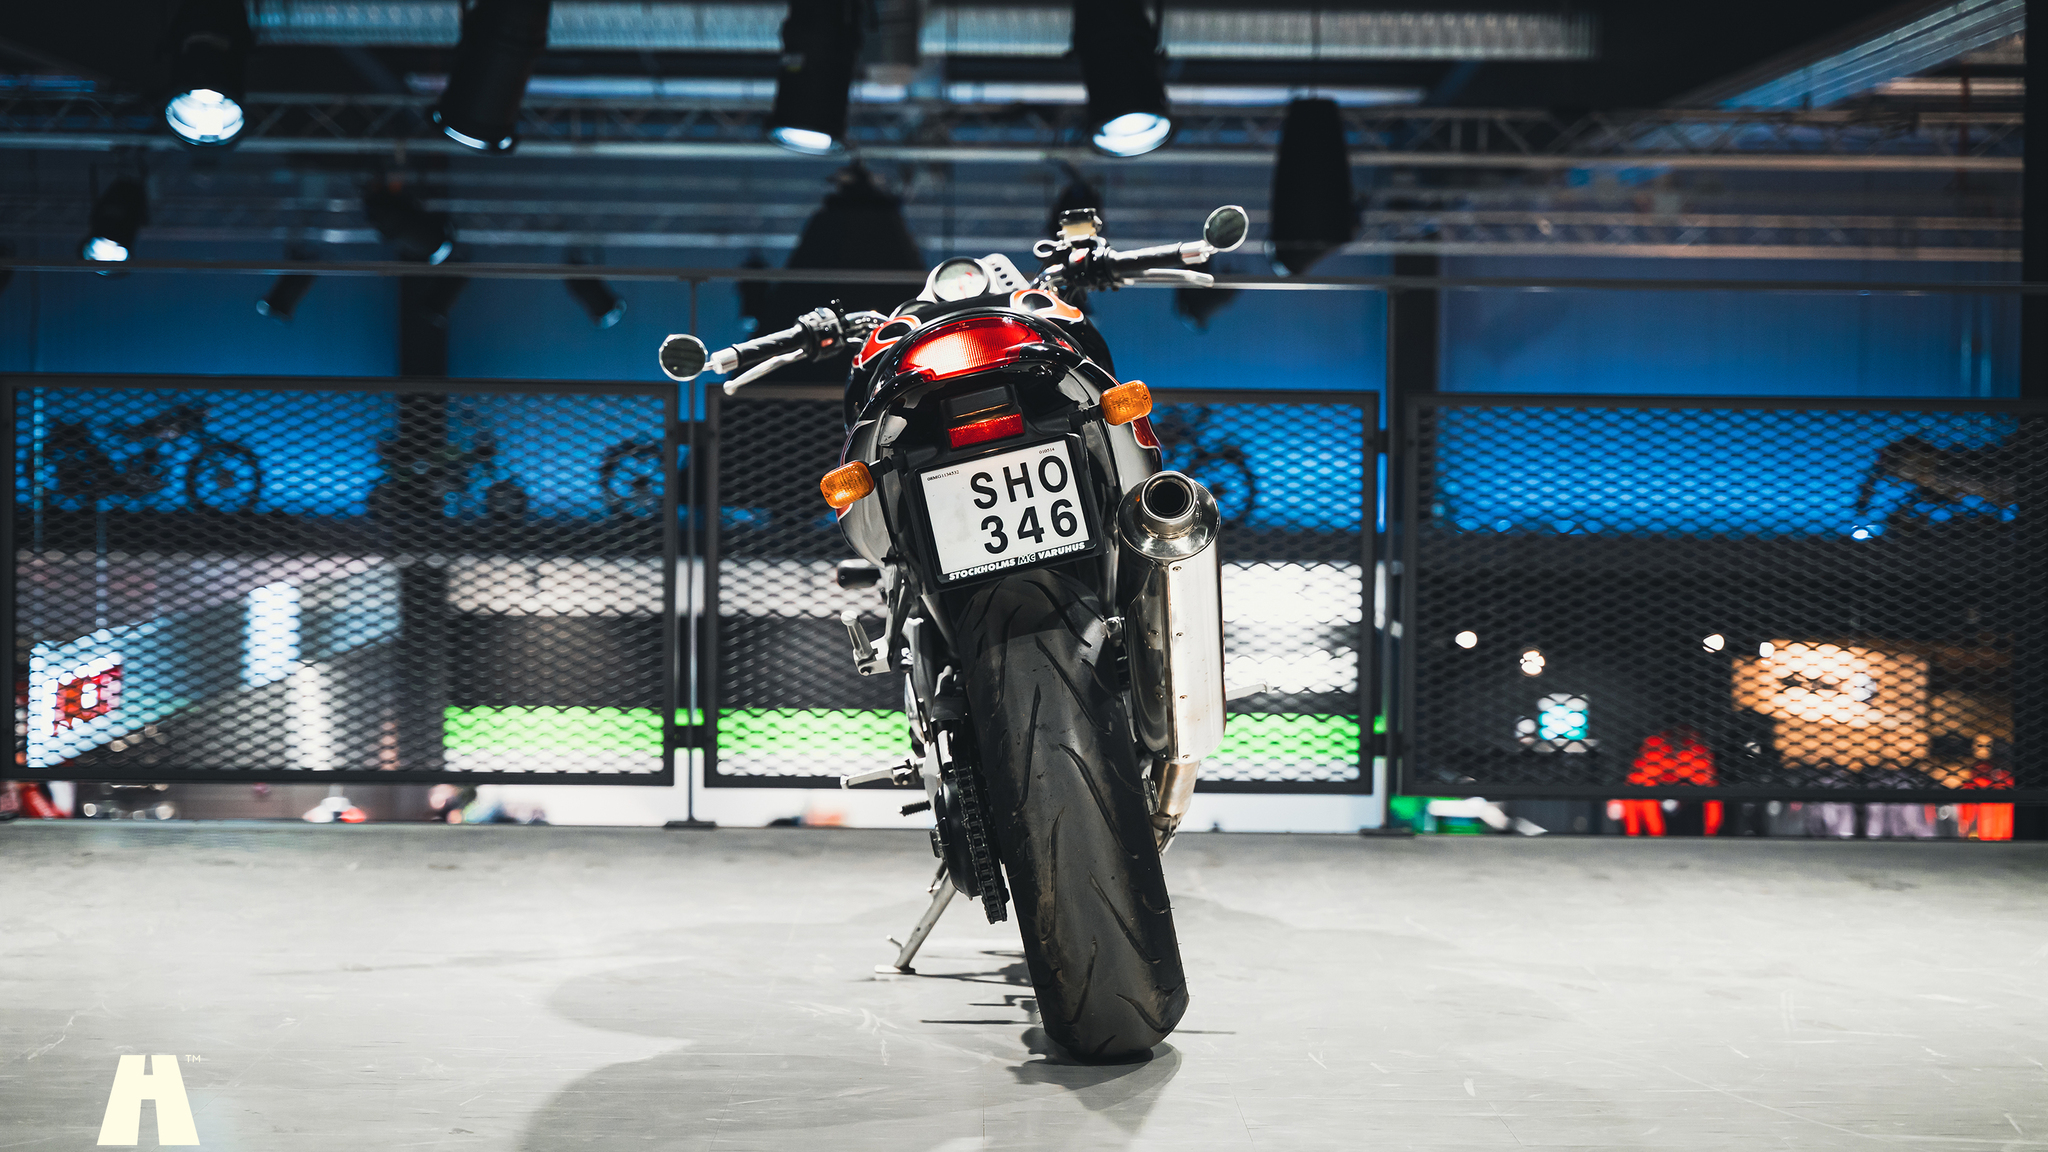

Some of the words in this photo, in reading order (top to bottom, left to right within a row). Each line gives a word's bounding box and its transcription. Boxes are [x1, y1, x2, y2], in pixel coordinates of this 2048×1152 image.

[970, 455, 1068, 510] SHO
[980, 498, 1078, 555] 346
[948, 558, 1016, 581] STOCKHOLMS
[1017, 553, 1036, 566] MC
[1037, 541, 1086, 560] VARUHUS
